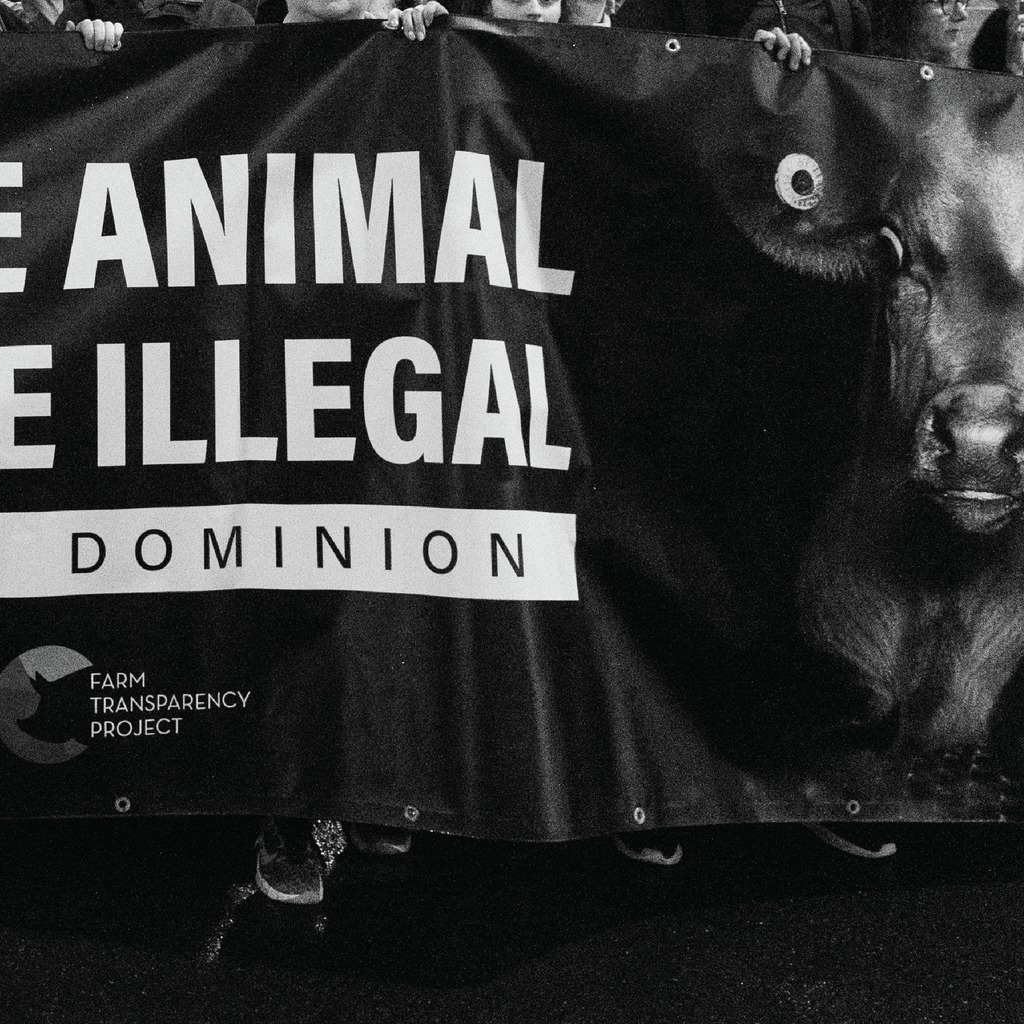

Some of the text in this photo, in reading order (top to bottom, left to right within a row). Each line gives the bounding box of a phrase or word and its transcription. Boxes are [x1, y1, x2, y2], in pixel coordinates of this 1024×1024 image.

[63, 150, 575, 297] ANIMAL
[96, 336, 573, 472] ILLEGAL
[71, 524, 526, 578] DOMINION
[90, 672, 145, 690] FARM
[90, 691, 251, 715] TRANSPARENCY
[91, 717, 183, 738] PROJECT
